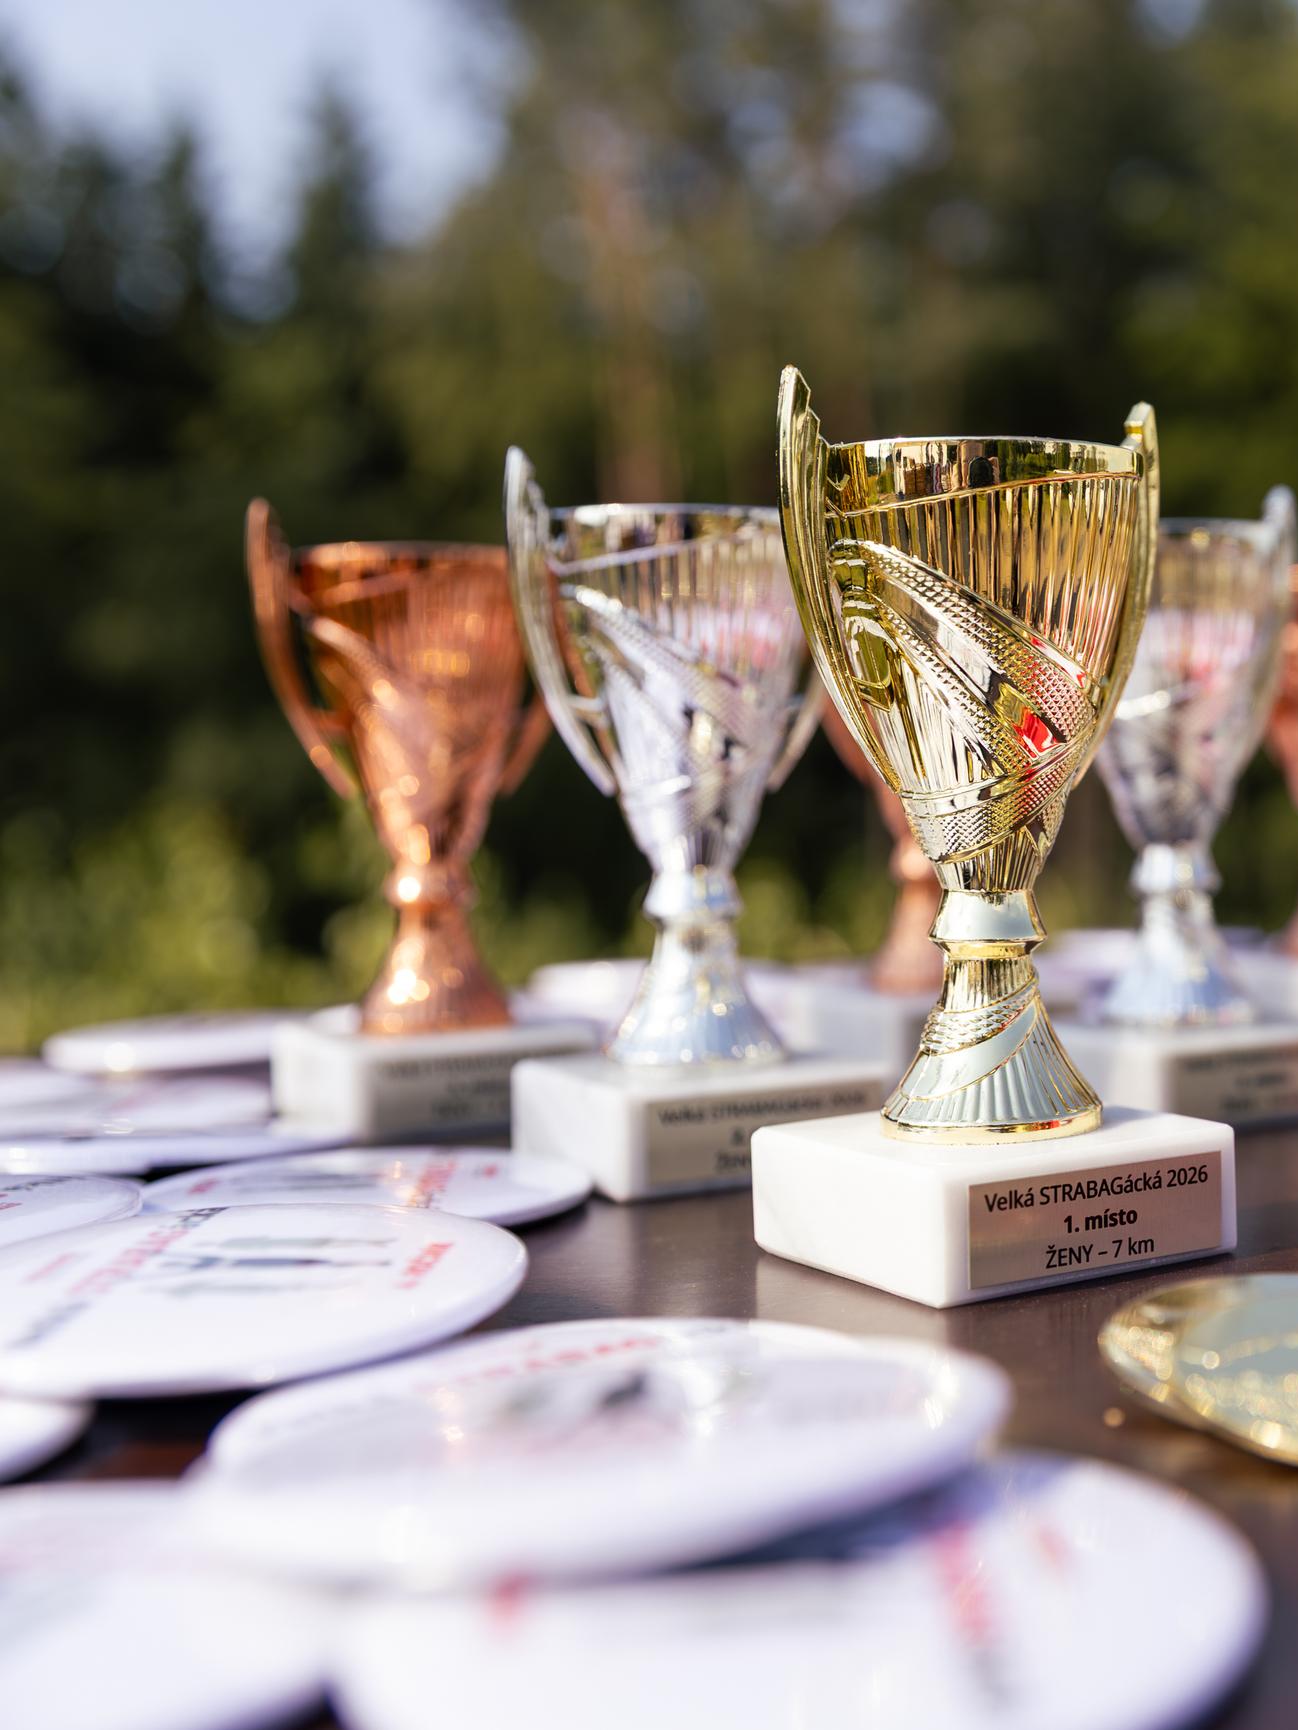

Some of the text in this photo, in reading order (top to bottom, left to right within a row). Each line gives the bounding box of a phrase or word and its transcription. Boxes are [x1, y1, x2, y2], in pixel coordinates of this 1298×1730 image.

[985, 1165, 1208, 1212] Velká STRABAGácká 2026
[1063, 1207, 1138, 1234] 1. místo
[1046, 1243, 1093, 1270] ŽENY
[1112, 1240, 1123, 1258] 7
[1128, 1236, 1155, 1256] km
